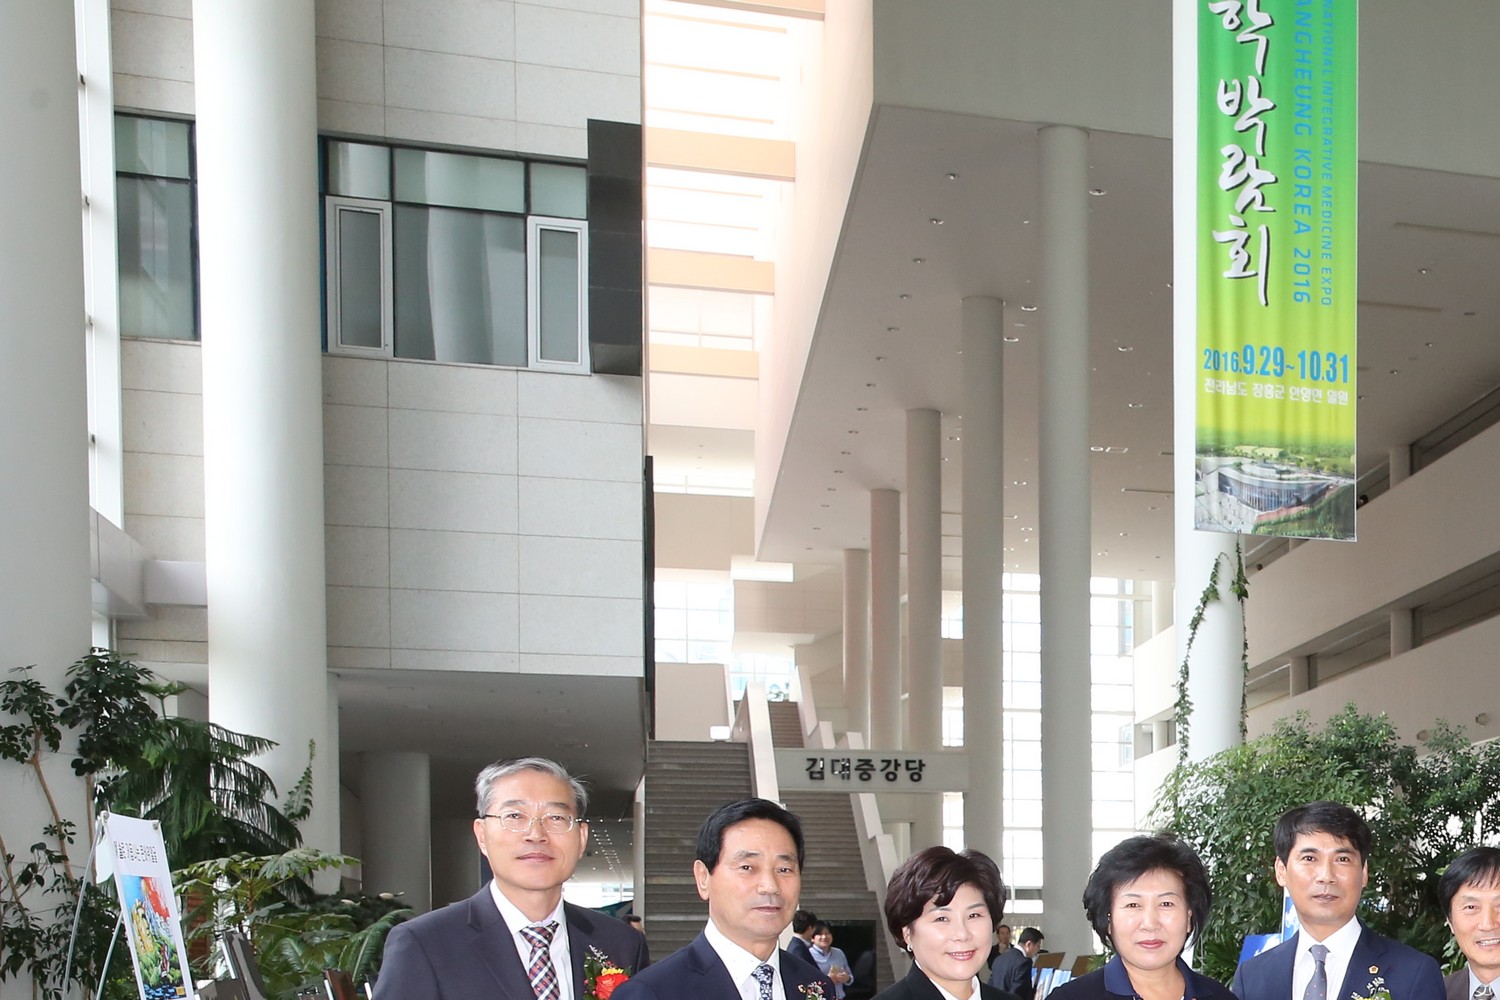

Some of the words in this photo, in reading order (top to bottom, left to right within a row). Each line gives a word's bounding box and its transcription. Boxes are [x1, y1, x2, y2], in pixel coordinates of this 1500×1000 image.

[1322, 82, 1333, 180] INTEGRATIVE
[1294, 149, 1312, 235] KOREA
[1322, 186, 1332, 259] MEDICINE
[1293, 248, 1311, 303] 2016
[1321, 267, 1332, 306] EXPO
[1205, 377, 1247, 396] 전라남도
[1253, 383, 1284, 400] 장흥군
[805, 757, 926, 782] 김대중강당
